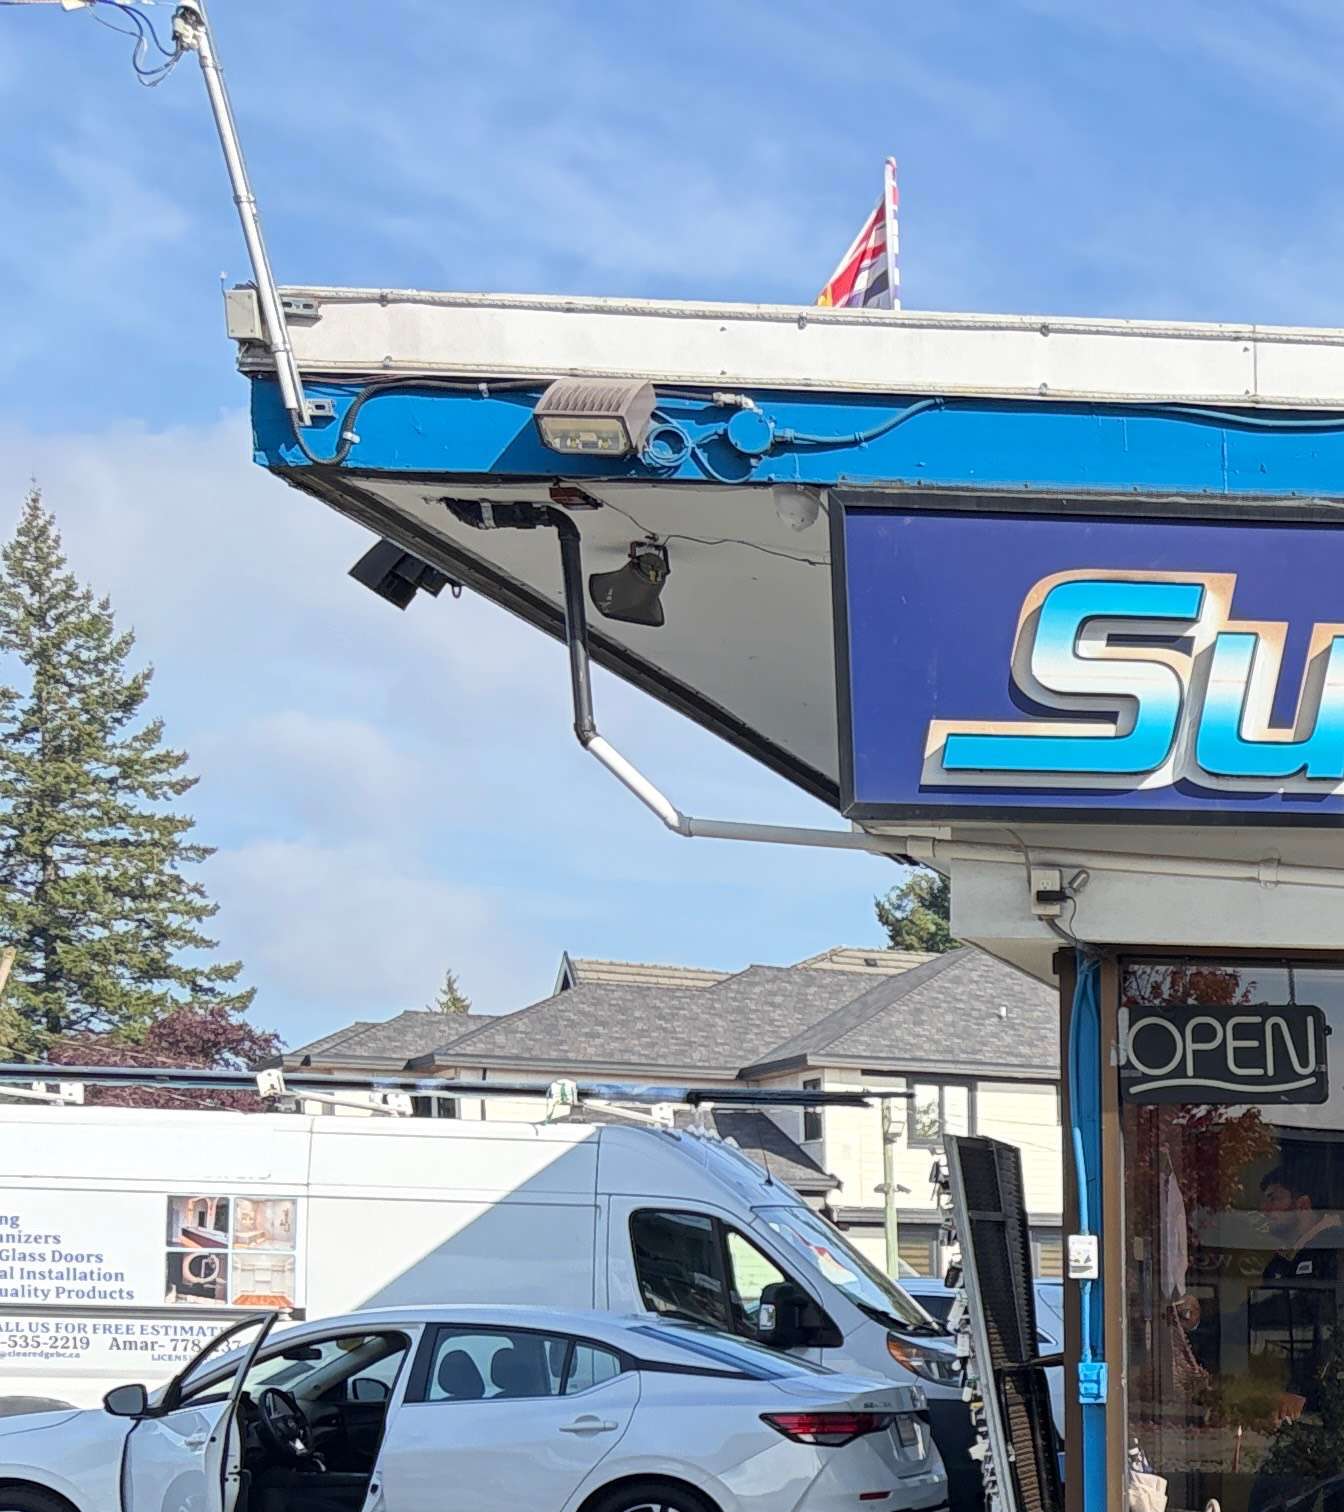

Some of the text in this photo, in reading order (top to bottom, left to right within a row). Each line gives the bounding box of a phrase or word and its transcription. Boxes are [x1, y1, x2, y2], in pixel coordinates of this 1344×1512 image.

[1127, 1015, 1317, 1077] OPEN
[0, 1247, 104, 1264] Glass Doors
[20, 1267, 125, 1282] Installation
[0, 1284, 135, 1301] uality Products
[28, 1322, 50, 1334] US
[55, 1322, 88, 1334] FOR
[92, 1323, 136, 1336] FREE
[140, 1324, 224, 1337] ESTIMAT
[108, 1337, 165, 1352] Amar-
[151, 1353, 193, 1363] LICENS
